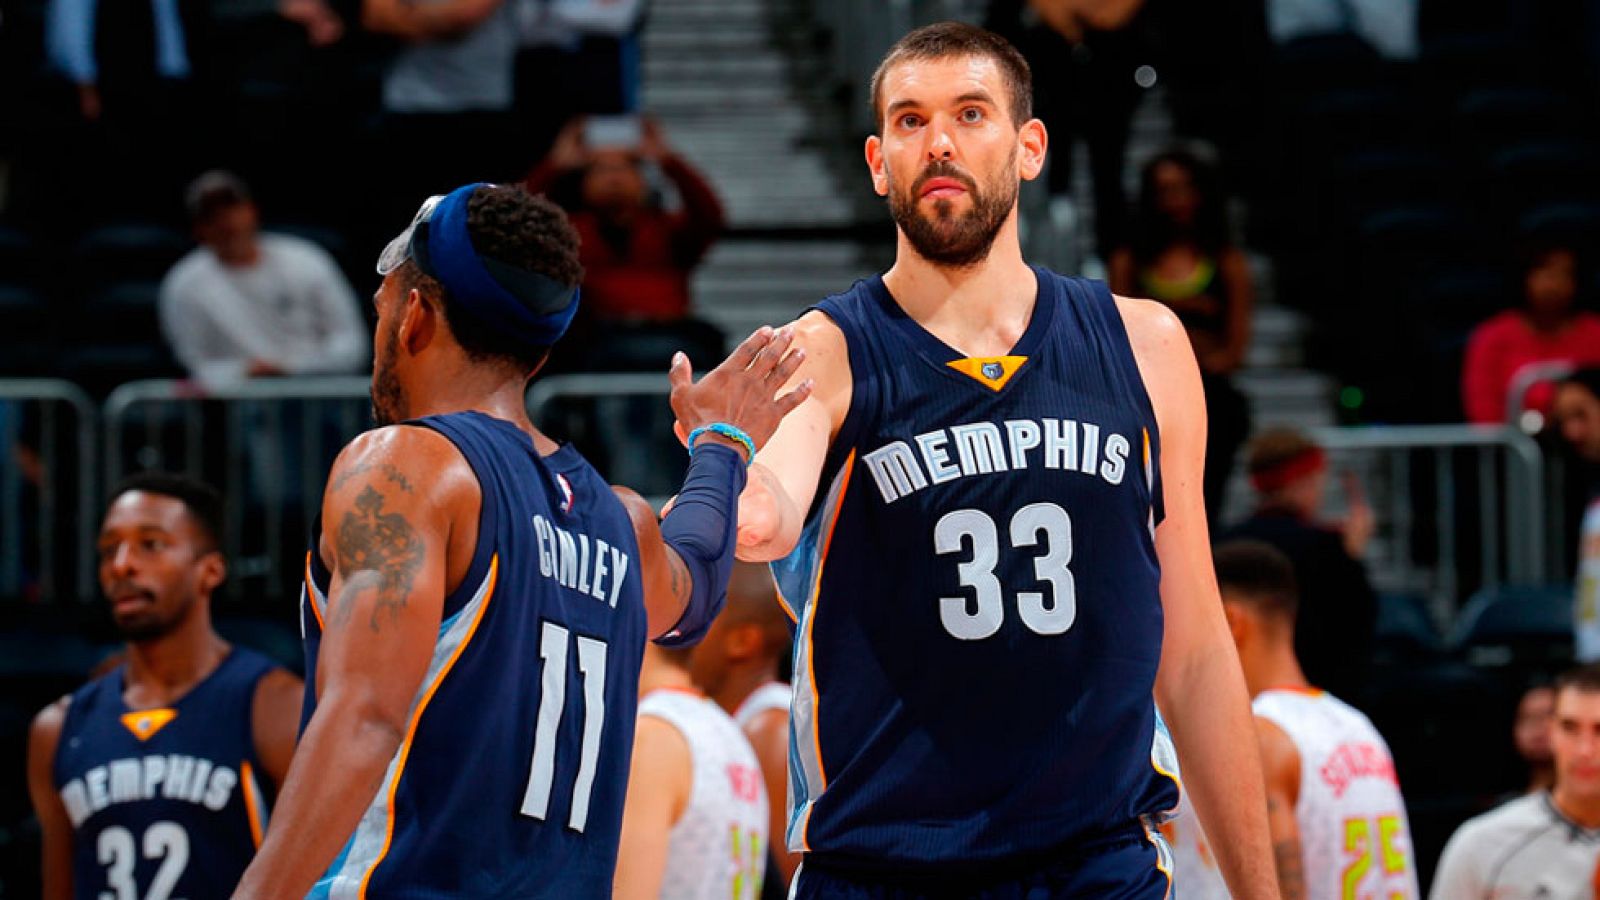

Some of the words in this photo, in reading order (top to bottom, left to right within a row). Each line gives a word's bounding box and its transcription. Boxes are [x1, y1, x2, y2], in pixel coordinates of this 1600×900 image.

[862, 418, 1131, 504] MEMPHIS
[934, 502, 1077, 640] 33
[520, 620, 608, 834] 11
[97, 820, 190, 900] 32
